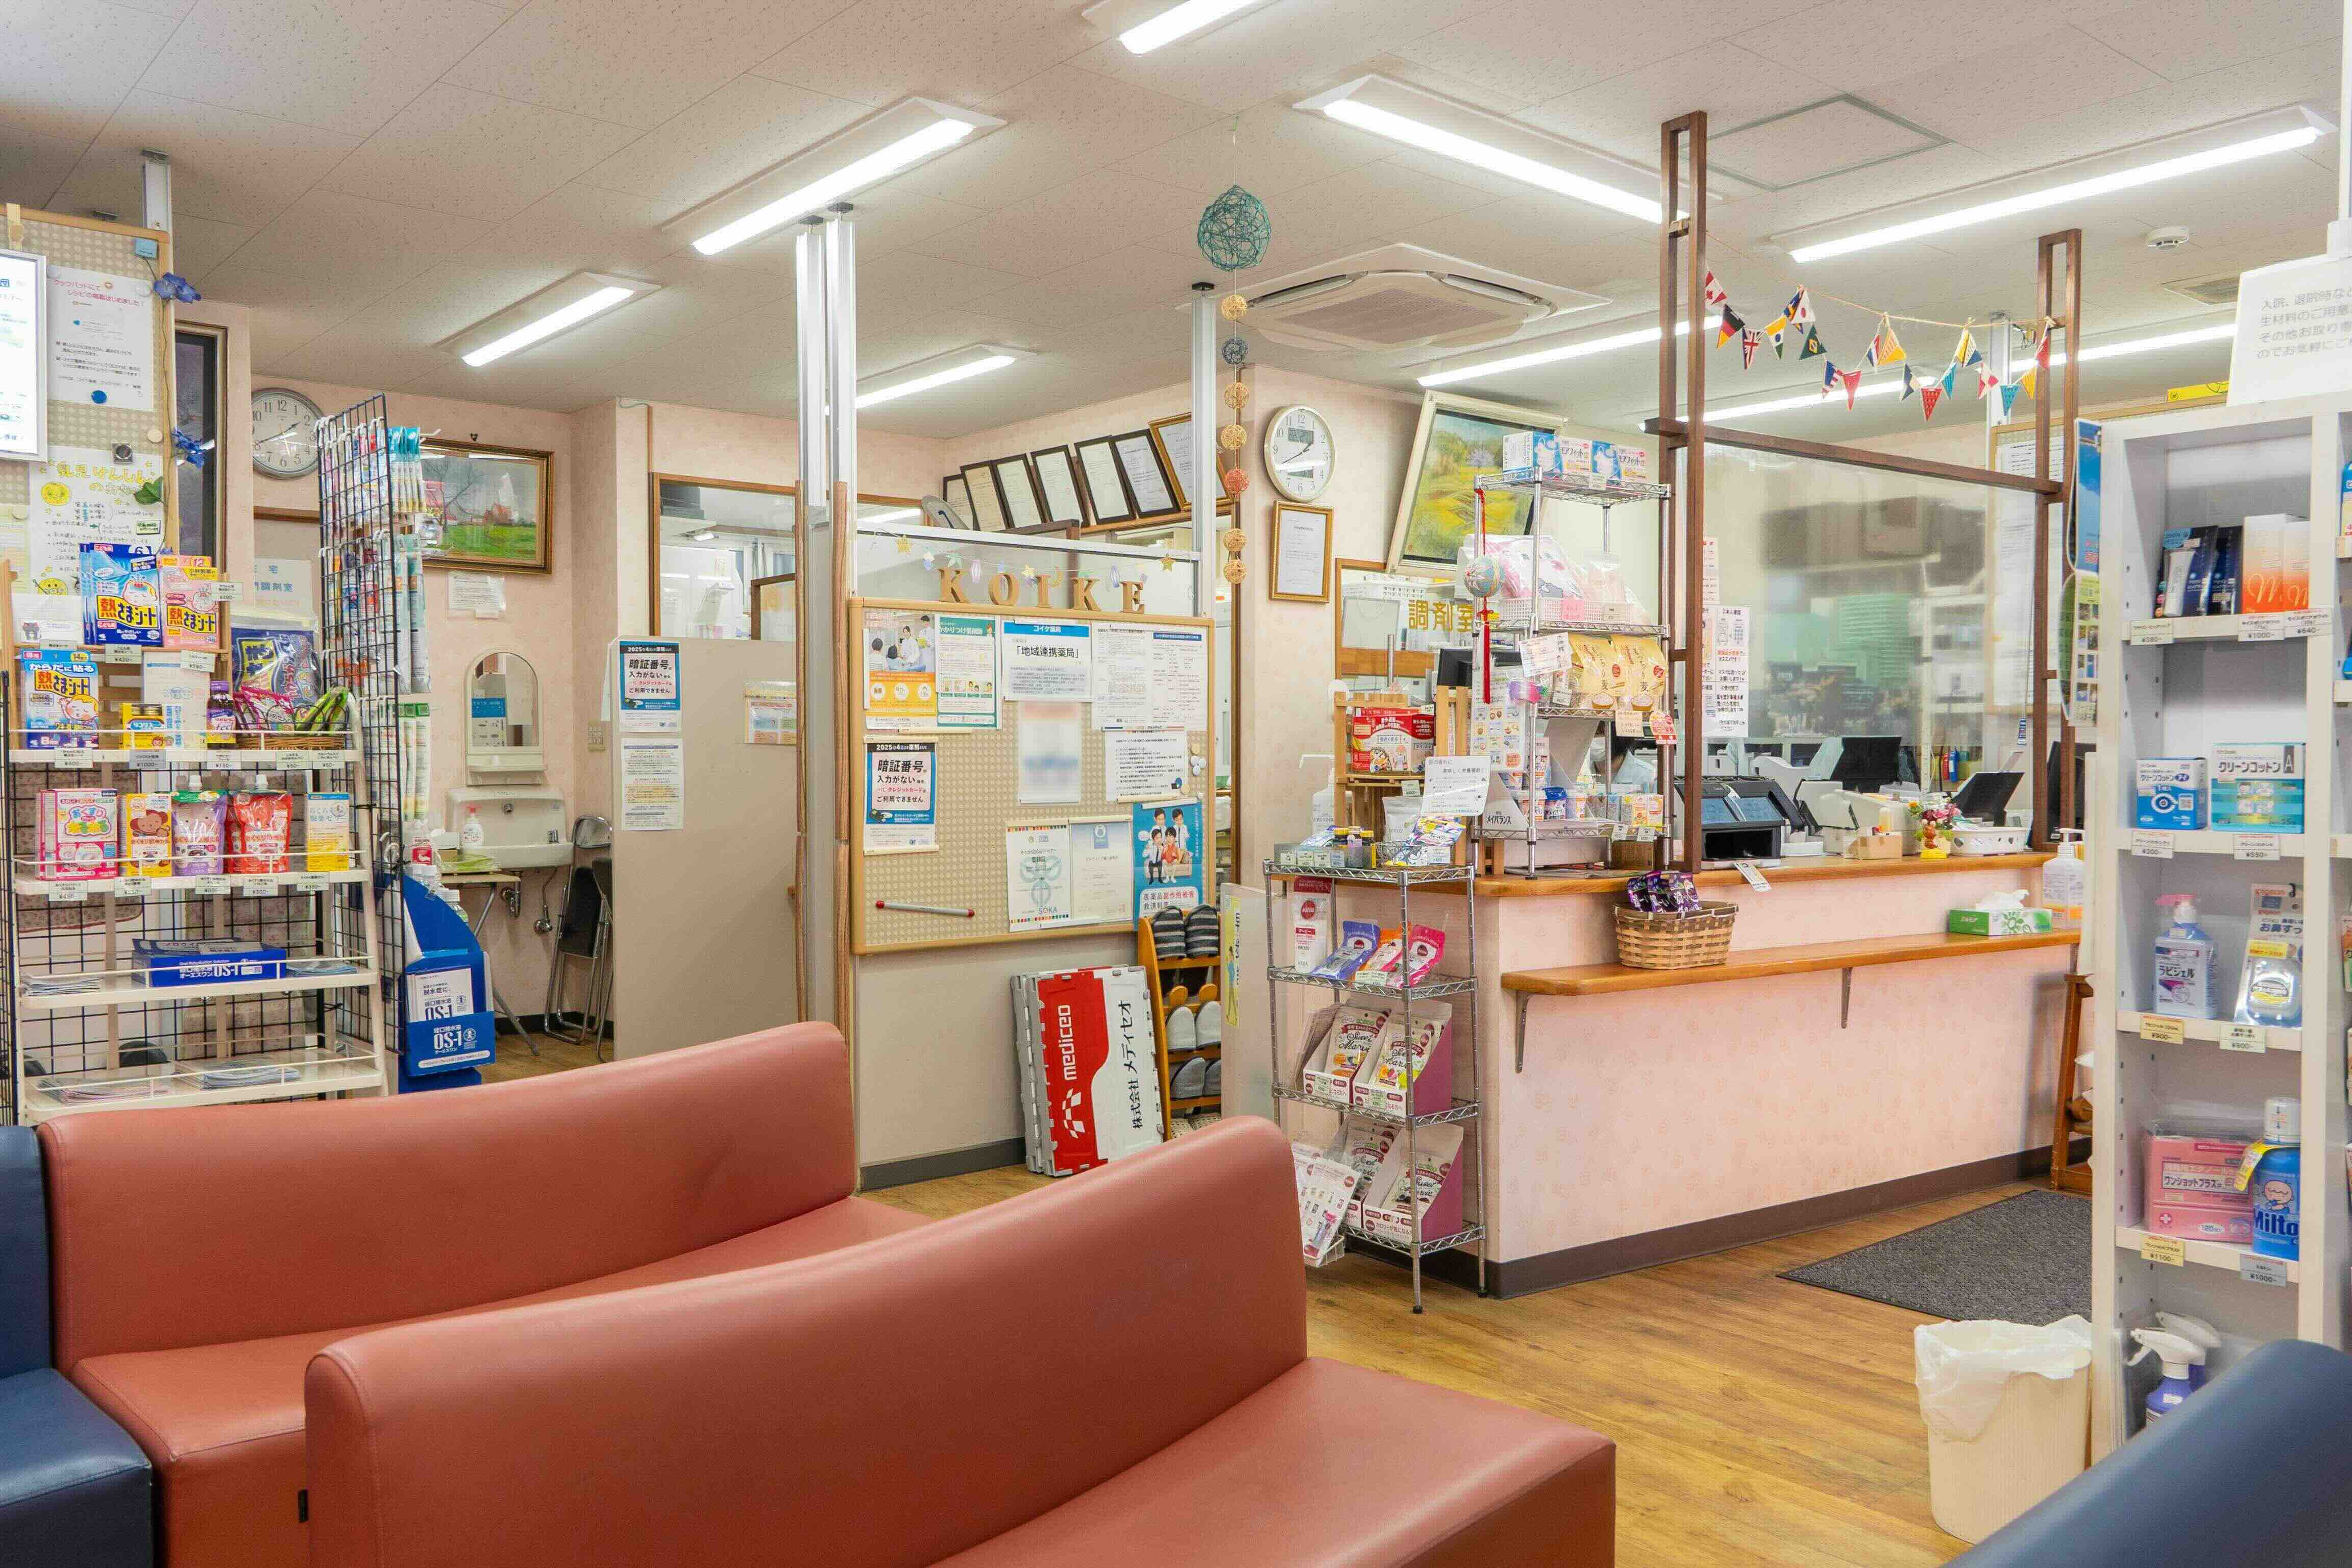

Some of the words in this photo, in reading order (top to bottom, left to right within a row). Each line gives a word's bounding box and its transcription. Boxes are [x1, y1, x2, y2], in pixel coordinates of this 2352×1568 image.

[265, 402, 272, 412] 11
[278, 400, 287, 411] 12
[295, 405, 298, 415] 1
[304, 414, 310, 426] 2
[1286, 416, 1292, 426] 11
[1298, 414, 1306, 424] 12
[1275, 428, 1283, 437] 10
[1319, 434, 1326, 444] 2
[1273, 445, 1278, 454] 9
[266, 451, 273, 462] 7
[281, 457, 287, 467] 6
[1298, 483, 1303, 493] 6
[936, 567, 1145, 614] KOIKE
[100, 598, 157, 626] 熱さまシート
[1409, 600, 1474, 632] 調剤室
[169, 607, 215, 631] 熱さまシート
[38, 671, 90, 695] 熱さまシート
[2284, 755, 2293, 772] A
[1486, 815, 1511, 825] メイバランス
[214, 963, 239, 977] OS-1
[425, 1004, 453, 1021] OS-1
[434, 1030, 462, 1050] OS-1
[1058, 1004, 1077, 1081] mediceo
